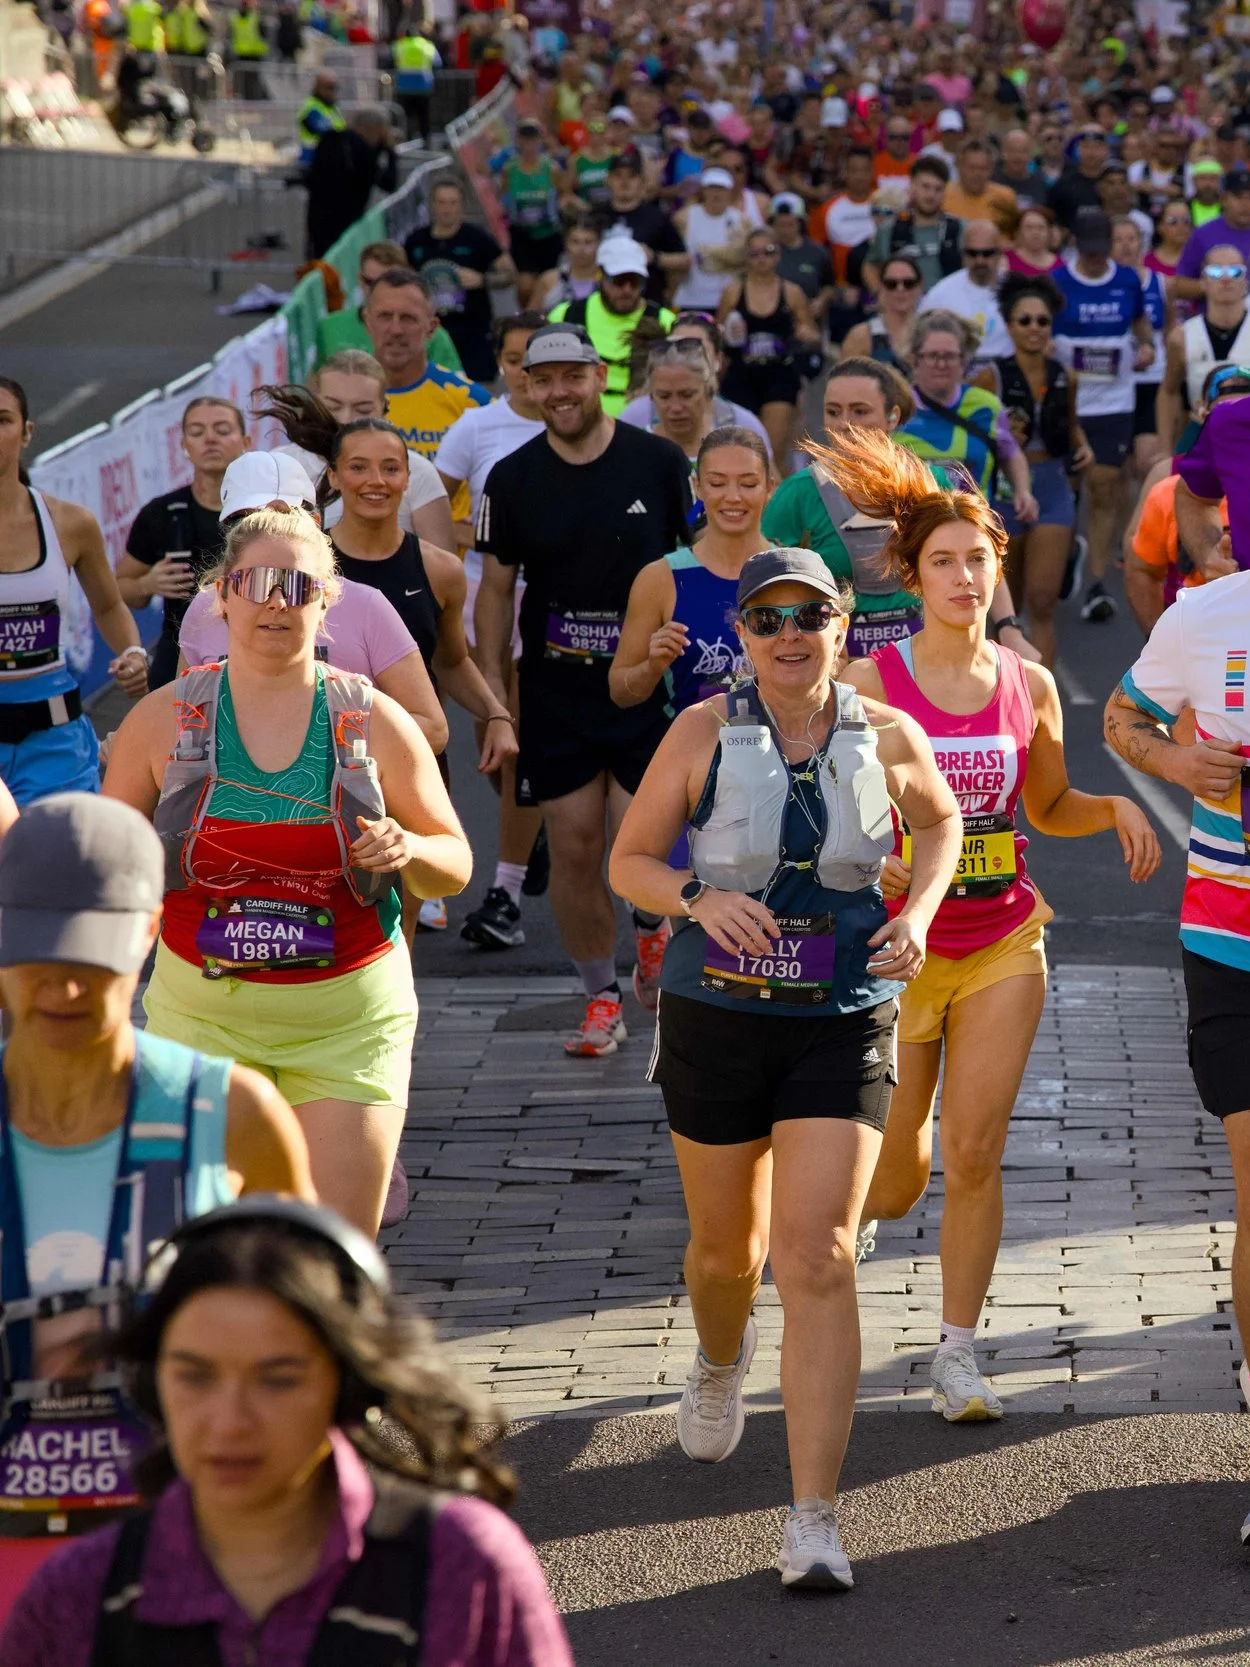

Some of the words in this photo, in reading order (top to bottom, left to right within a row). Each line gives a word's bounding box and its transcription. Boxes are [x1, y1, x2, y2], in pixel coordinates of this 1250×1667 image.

[397, 426, 449, 443] Mar
[560, 621, 621, 639] JOSHUA
[853, 624, 912, 641] REBECA
[571, 636, 609, 652] 9825
[726, 737, 765, 746] OSPREY
[934, 750, 1006, 772] BREAST
[942, 771, 1006, 792] ANCER
[978, 818, 996, 827] HALF
[246, 900, 284, 911] CARDIFF
[284, 904, 309, 914] HALF
[224, 921, 304, 940] MEGAN
[790, 918, 812, 927] HALF
[229, 942, 298, 960] 19814
[737, 955, 802, 979] 17030
[4, 1462, 119, 1496] 28566
